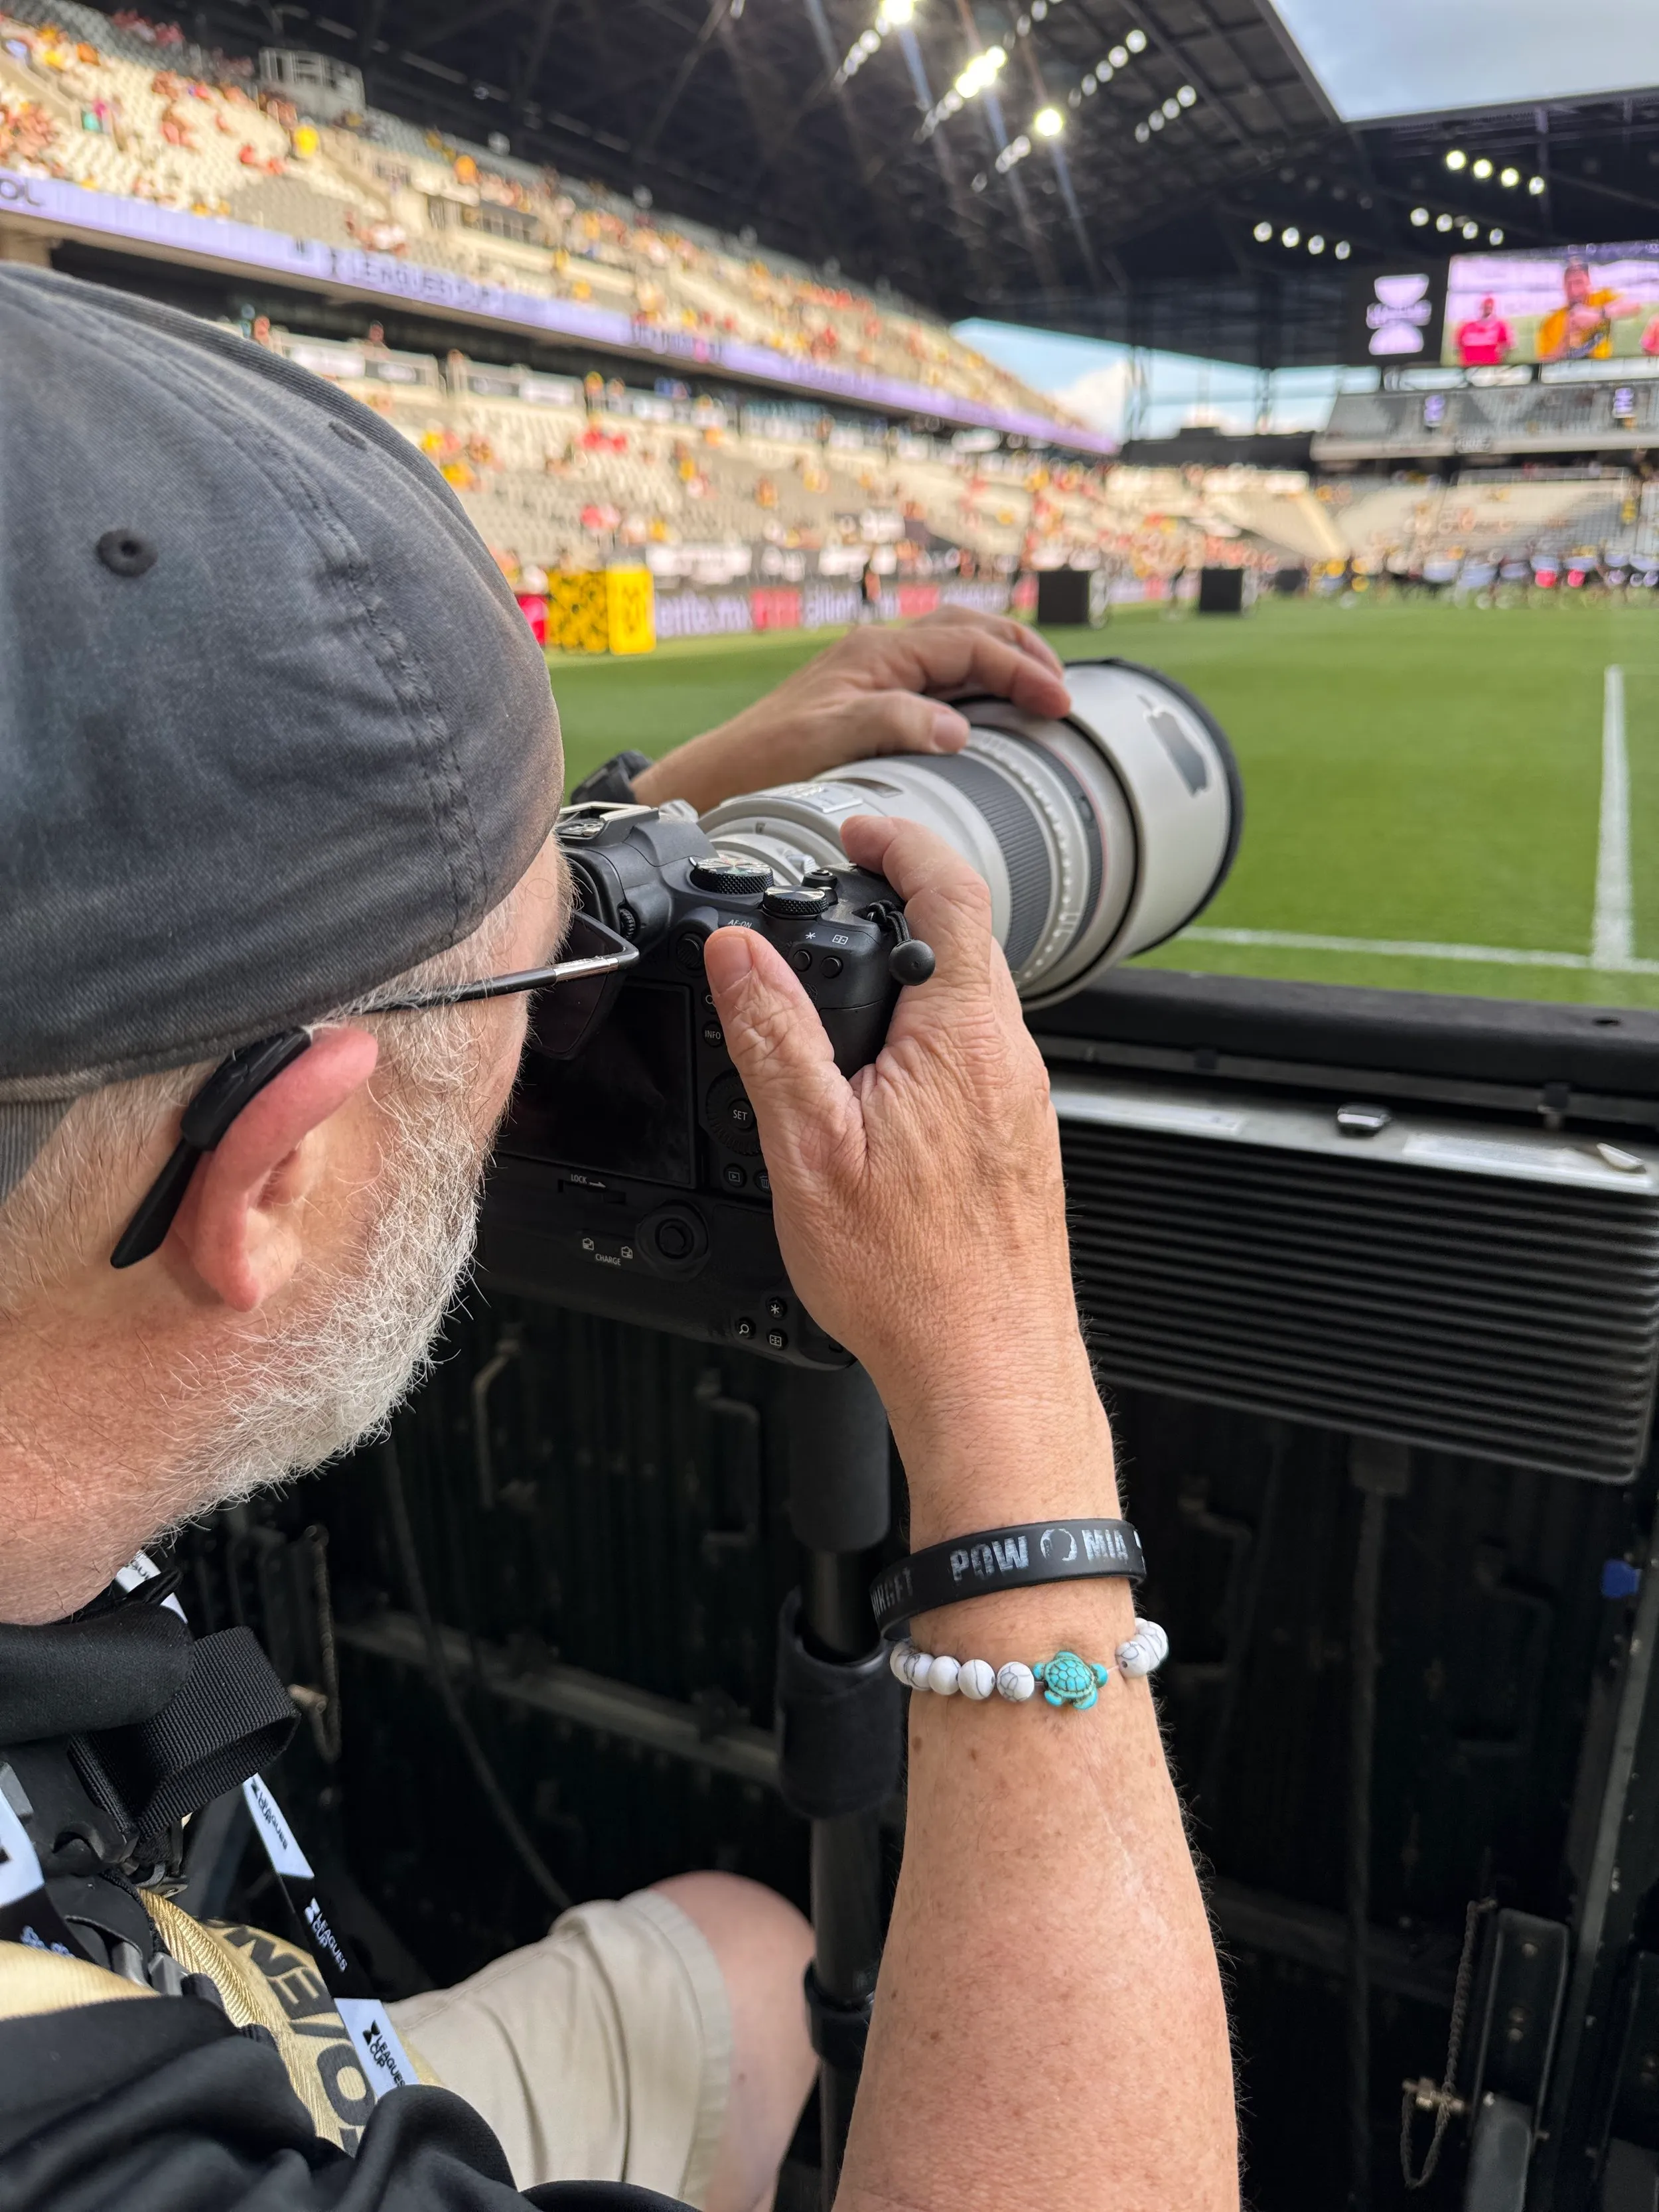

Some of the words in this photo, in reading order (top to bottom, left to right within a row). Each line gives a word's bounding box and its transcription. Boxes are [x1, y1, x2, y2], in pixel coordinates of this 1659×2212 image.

[728, 919, 753, 928] AF-ON
[705, 1029, 721, 1040] INFO
[733, 1109, 748, 1121] SET
[571, 1173, 588, 1184] LOCK
[595, 1254, 621, 1266] CHARGE
[949, 1535, 1029, 1583] POW
[1081, 1529, 1129, 1562] MIA
[311, 1919, 328, 1949] CUP
[317, 1912, 348, 1973] LEAGUES
[370, 2042, 386, 2068] CUP
